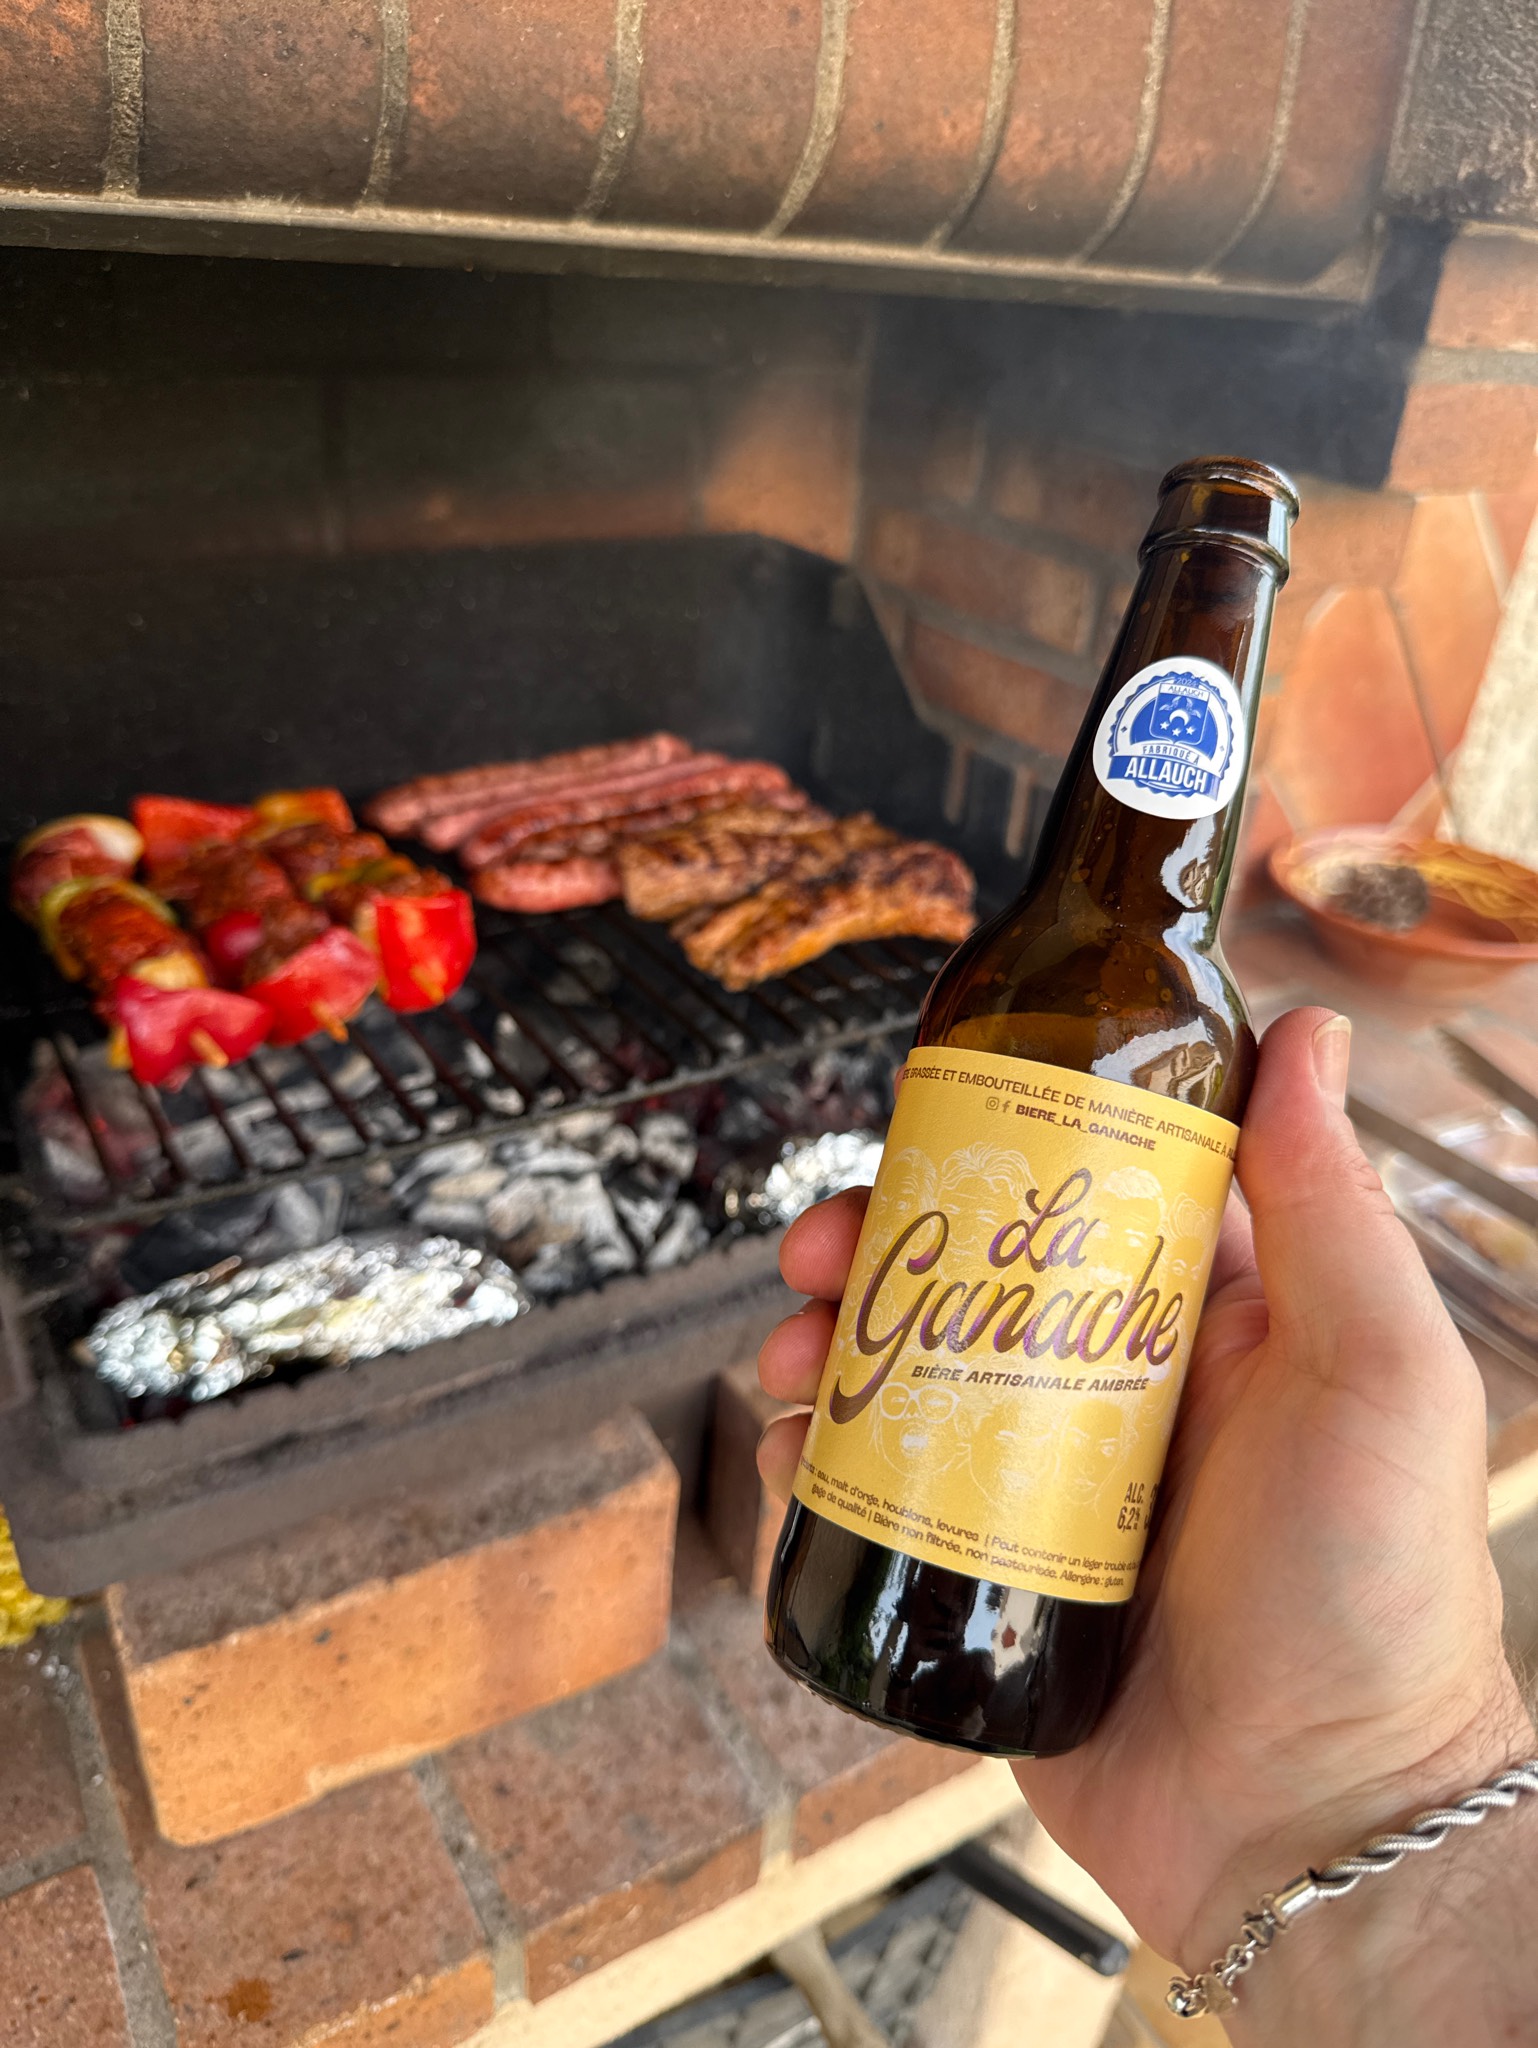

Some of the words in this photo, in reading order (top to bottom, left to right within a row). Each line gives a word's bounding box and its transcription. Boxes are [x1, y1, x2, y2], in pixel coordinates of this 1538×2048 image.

[1168, 685, 1203, 697] ALLAUCH
[1176, 677, 1197, 687] 2024
[1143, 745, 1191, 760] FABRIQUÉ
[1124, 757, 1208, 793] ALLAUCH
[910, 1065, 942, 1079] BRASSÉE
[943, 1069, 957, 1081] ET
[958, 1072, 1061, 1103] EMBOUTEILLÉE
[1064, 1093, 1085, 1110] DE
[1088, 1099, 1155, 1129] MANIÈRE
[1155, 1120, 1222, 1154] ARTISANALE
[1016, 1104, 1156, 1151] BIERE_LA_GANACHE
[988, 1167, 1099, 1273] La
[829, 1211, 1183, 1425] Ganache
[911, 1364, 963, 1382] BIÈRE
[965, 1371, 1086, 1392] ARTISANALE
[1087, 1376, 1149, 1392] AMBRÉE
[1124, 1482, 1144, 1504] ALC.
[811, 1483, 826, 1498] gage
[827, 1491, 837, 1503] de
[837, 1499, 867, 1517] qualité
[873, 1511, 900, 1531] Bière
[901, 1526, 923, 1541] non
[926, 1532, 963, 1555] filtrée,
[965, 1546, 988, 1562] non
[817, 1470, 829, 1484] eau,
[831, 1477, 848, 1492] malt
[882, 1498, 933, 1528] houblons,
[936, 1518, 979, 1542] levures
[991, 1535, 1019, 1553] Peut
[1021, 1546, 1067, 1565] contenir
[1068, 1556, 1081, 1567] un
[1082, 1557, 1103, 1571] léger
